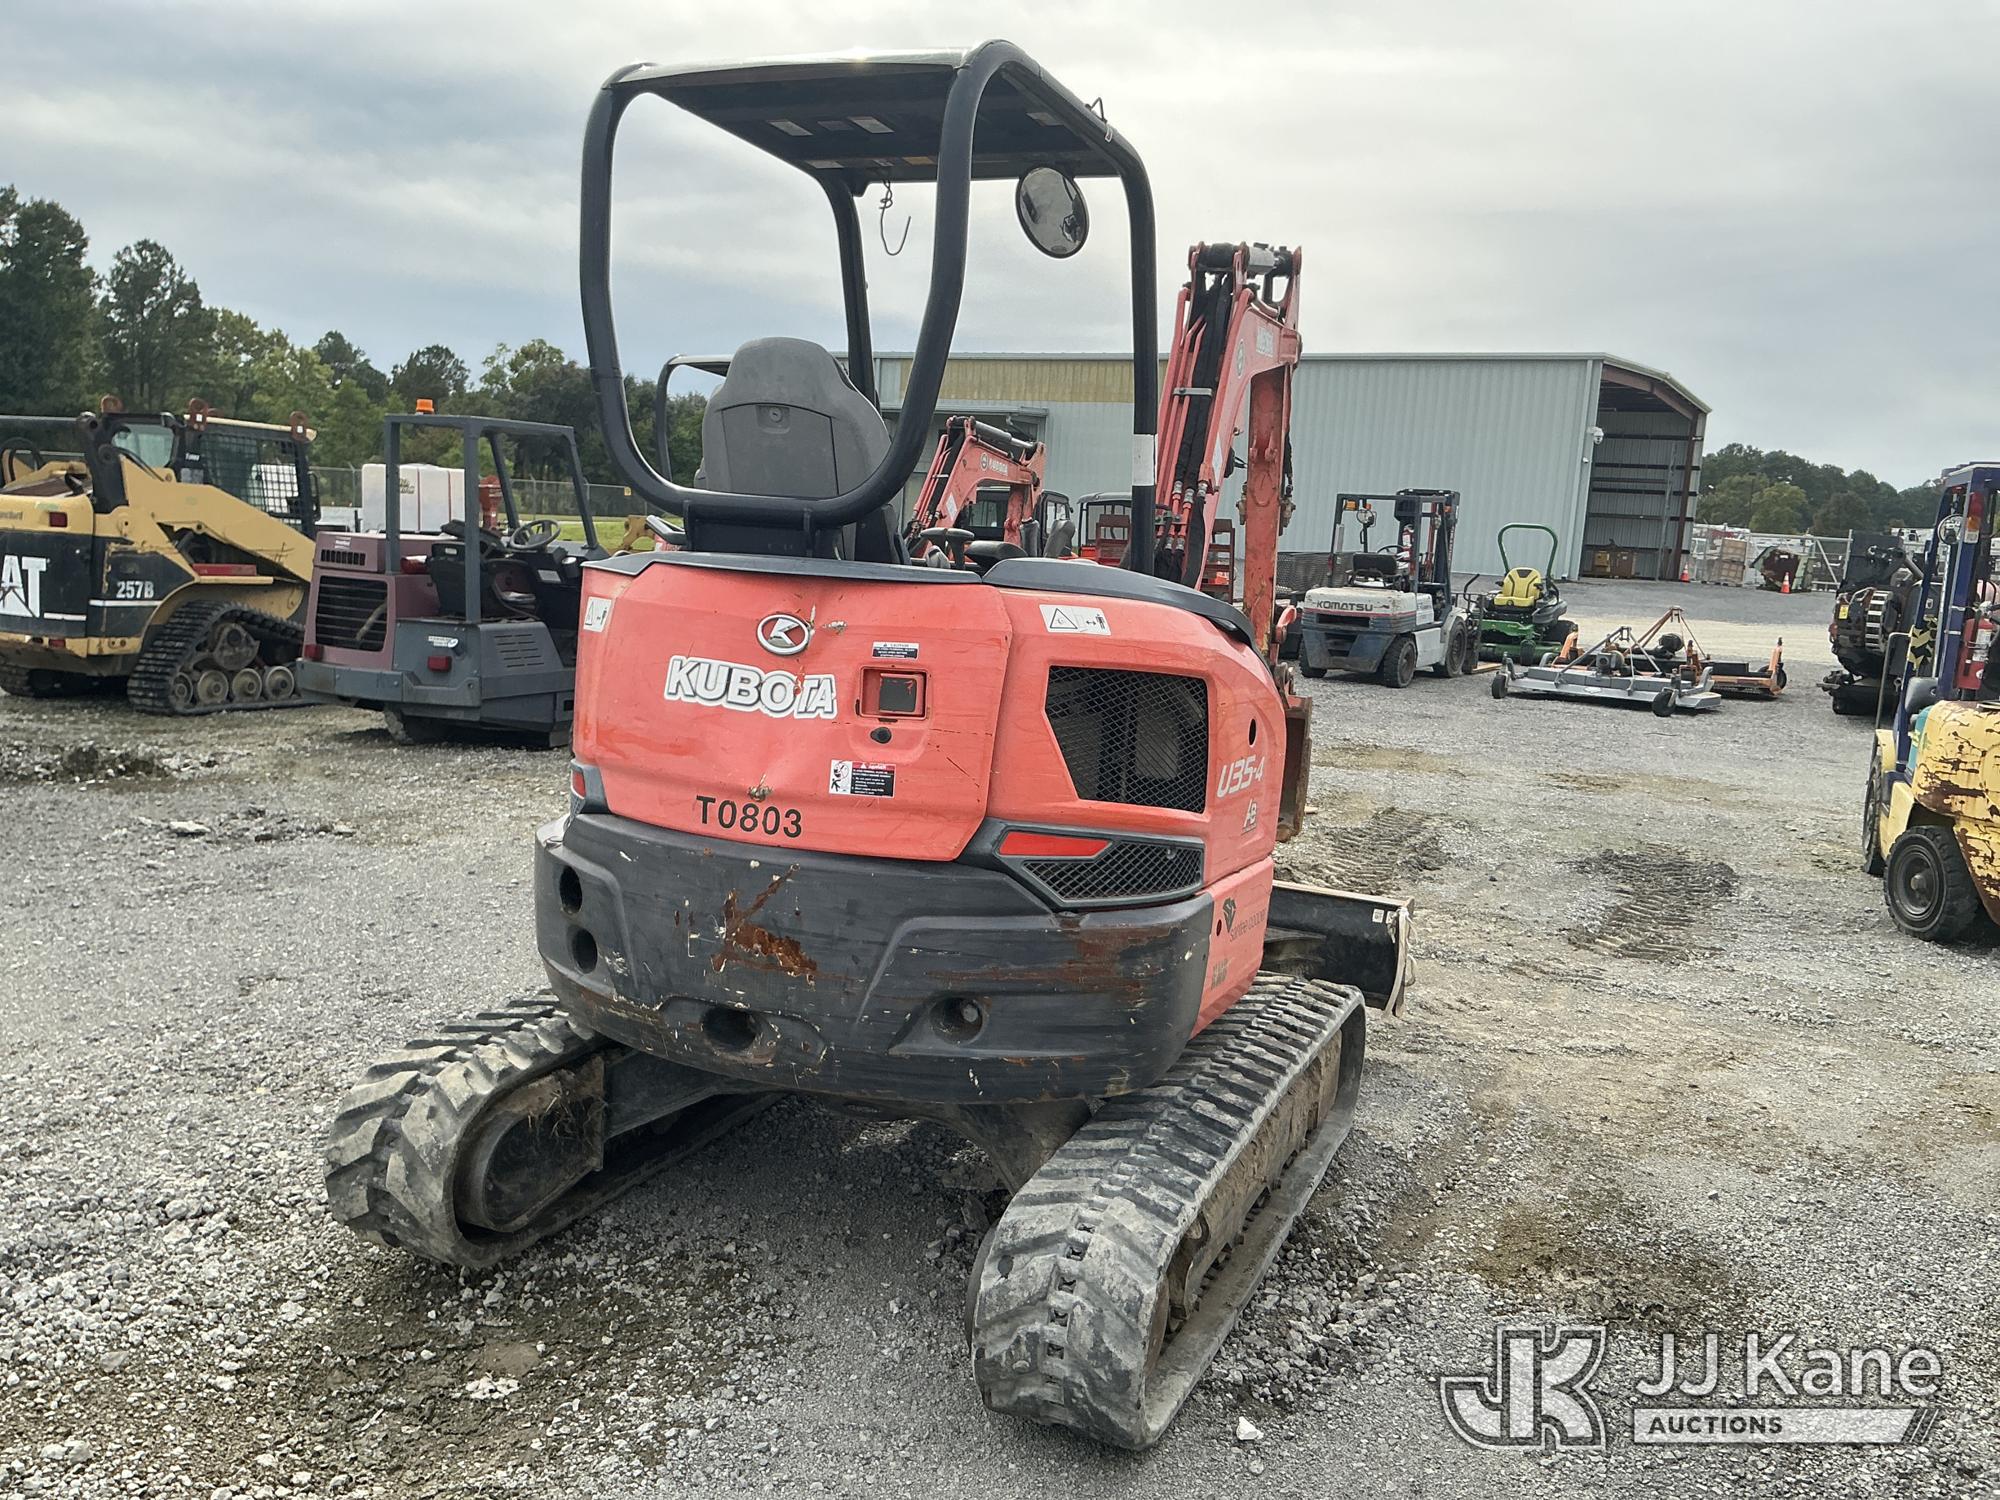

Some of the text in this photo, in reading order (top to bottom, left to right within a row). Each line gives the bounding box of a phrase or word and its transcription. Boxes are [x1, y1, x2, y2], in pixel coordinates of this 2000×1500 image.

[0, 554, 47, 618] AT
[116, 580, 154, 599] 257B
[1316, 600, 1373, 611] KOMATSU
[665, 656, 837, 718] KUBOTA
[1217, 754, 1265, 798] U35-4
[696, 795, 803, 838] T0803
